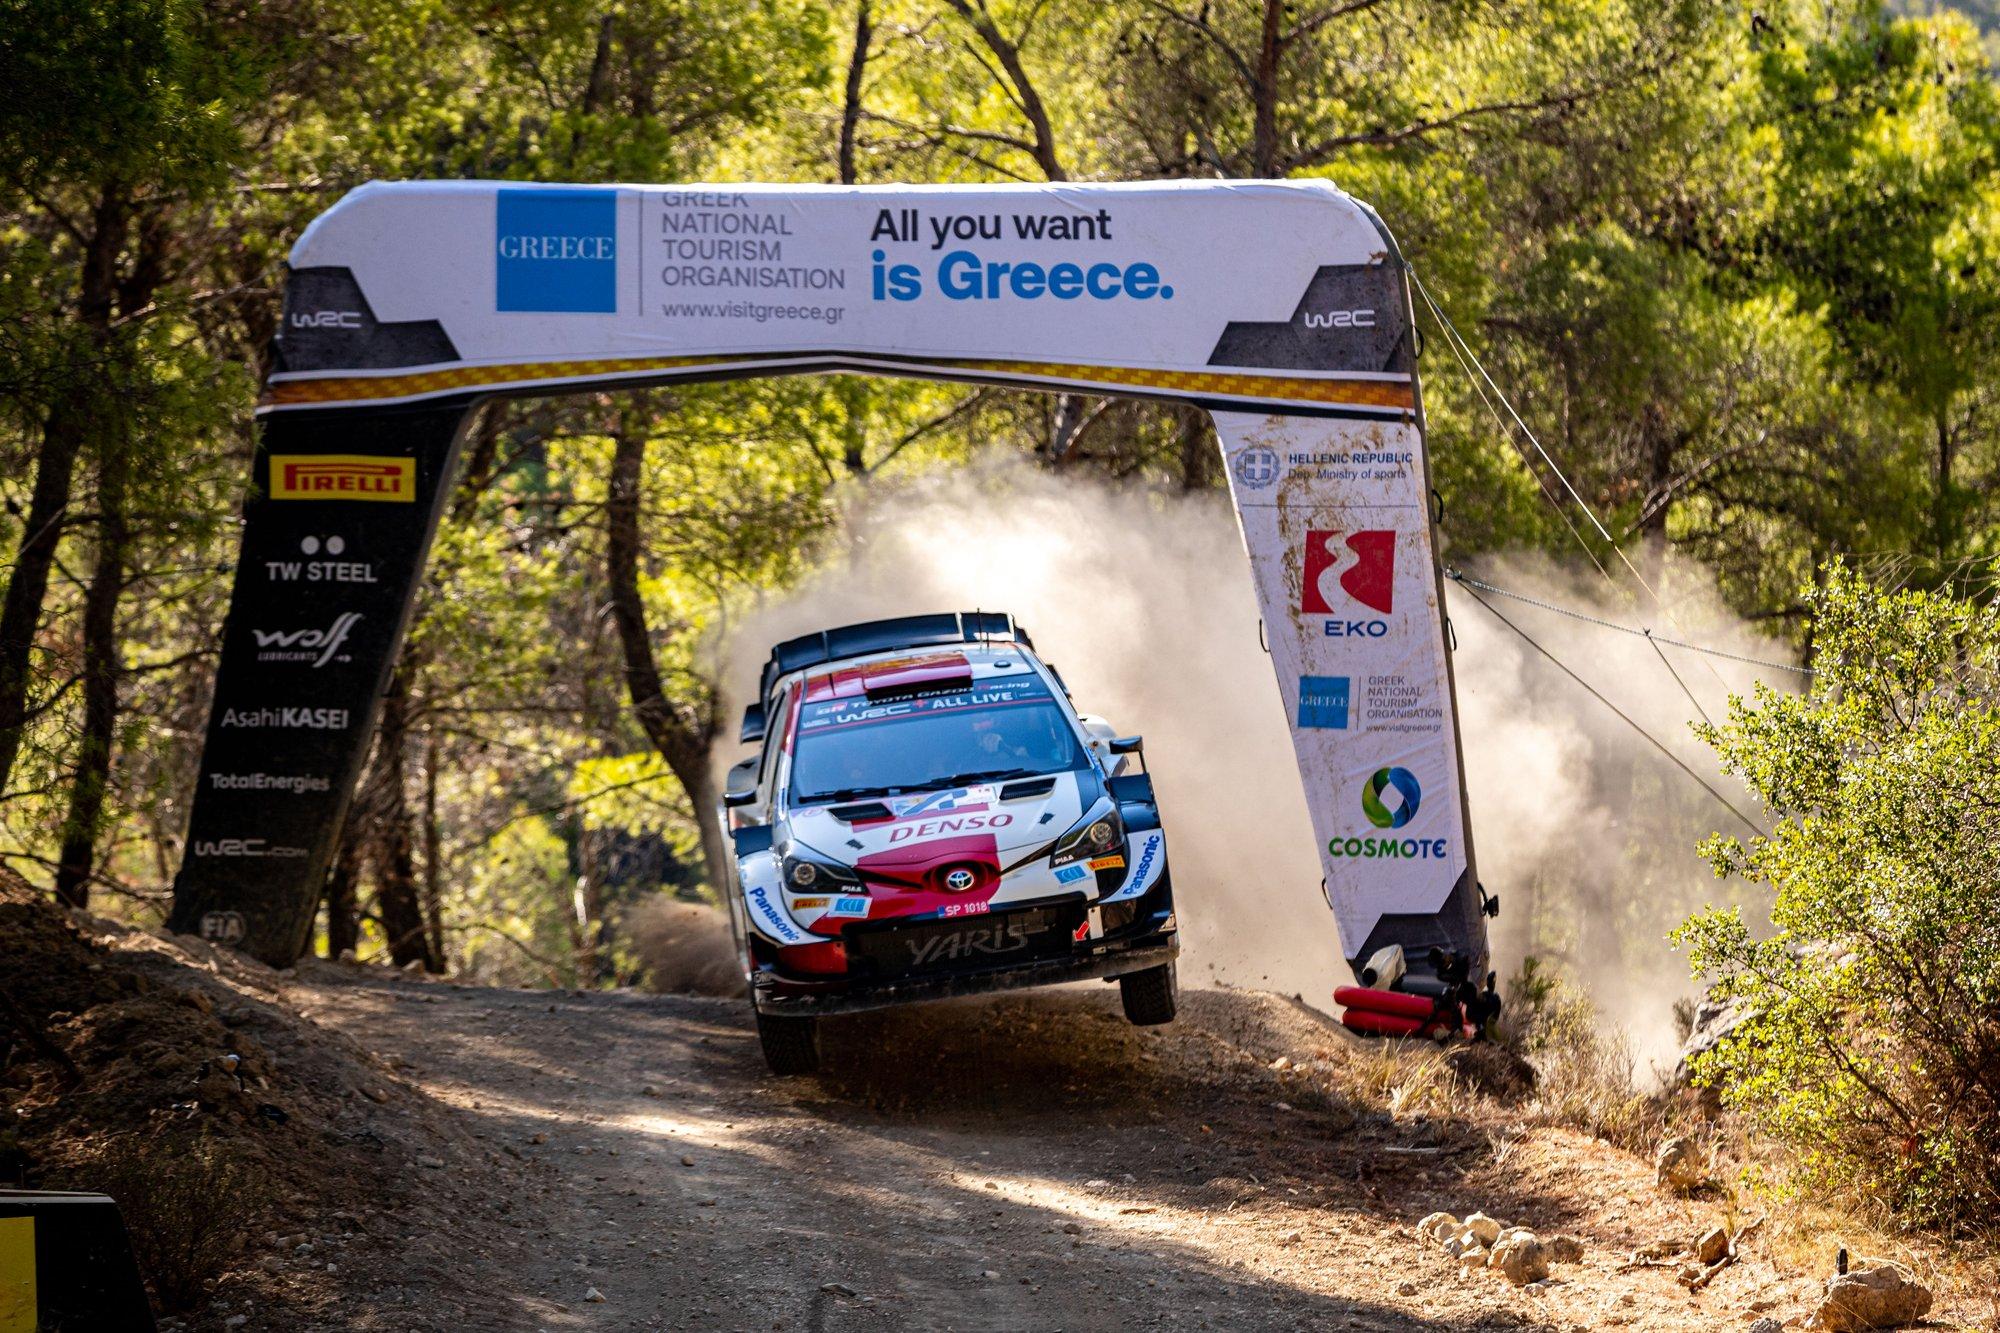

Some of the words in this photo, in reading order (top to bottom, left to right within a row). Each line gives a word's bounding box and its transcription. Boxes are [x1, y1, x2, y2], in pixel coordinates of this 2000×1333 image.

[662, 191, 749, 207] GREEK
[662, 213, 793, 236] NATIONAL
[870, 209, 918, 241] All
[930, 214, 1002, 250] you
[1013, 209, 1112, 240] want
[499, 236, 614, 260] GREECE
[662, 239, 782, 261] TOURISM
[661, 266, 846, 290] ORGANISATION
[872, 249, 922, 300] is
[937, 249, 1174, 300] Greece.
[291, 310, 362, 329] WRC
[662, 301, 846, 325] www.visitgreece.gr
[1305, 309, 1376, 328] WRC
[1289, 453, 1349, 464] HELLENIC
[1352, 452, 1414, 464] REPUBLIC
[284, 463, 403, 493] PIRELLI
[1316, 468, 1358, 480] Ministry
[1361, 468, 1371, 479] of
[1374, 469, 1407, 481] sports
[265, 561, 301, 581] TW
[307, 562, 378, 583] STEEL
[1325, 620, 1388, 637] EKO
[1368, 675, 1405, 685] GREEK
[932, 698, 968, 709] ALL
[972, 692, 1013, 704] LIVE
[1300, 695, 1348, 707] GREECE
[1367, 697, 1418, 708] TOURISM
[1368, 686, 1422, 697] NATIONAL
[221, 707, 349, 729] AsahiKASEI
[1367, 708, 1443, 719] ORGANISATION
[210, 773, 330, 795] TotalEnergies
[889, 814, 1014, 843] DENSO
[1328, 836, 1447, 859] COSMOTE
[1122, 835, 1160, 895] Panasonic
[749, 886, 800, 941] Panasonic
[945, 905, 961, 916] SP
[964, 901, 988, 914] 1018
